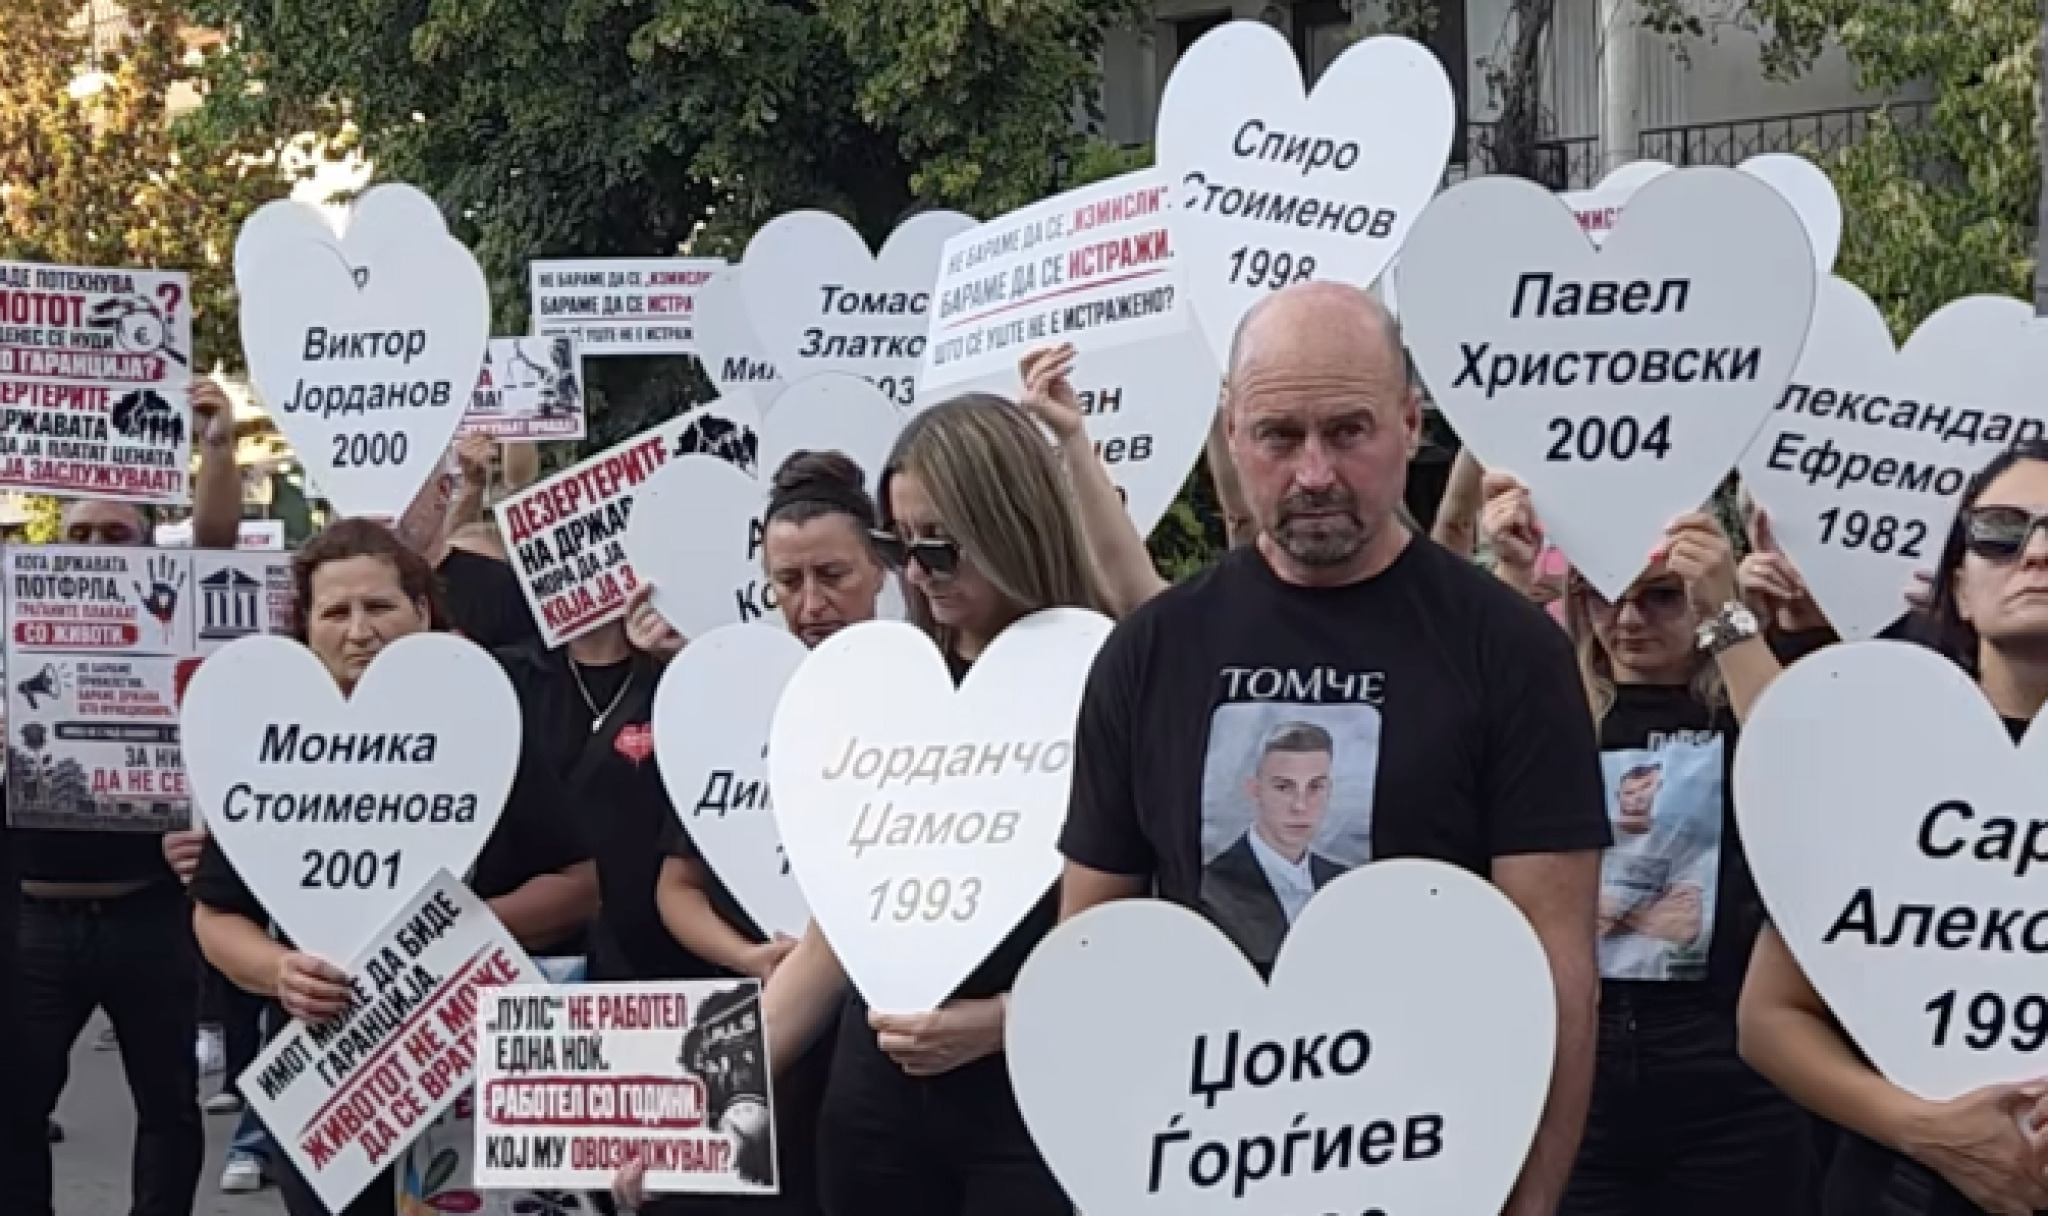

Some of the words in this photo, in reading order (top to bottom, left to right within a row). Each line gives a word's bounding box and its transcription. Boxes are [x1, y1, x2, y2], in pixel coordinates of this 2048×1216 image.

[1232, 119, 1360, 176] Спиро
[965, 227, 1022, 272] БАРАМЕ
[1023, 218, 1043, 250] ДА
[1046, 213, 1064, 239] СЕ
[37, 271, 135, 294] ПОТЕКНУВА
[940, 270, 1008, 319] БАРАМЕ
[1009, 260, 1037, 300] ДА
[1041, 252, 1064, 285] СЕ
[1068, 228, 1174, 279] ИСТРАЖИ.
[1510, 272, 1691, 318] Павел
[540, 295, 599, 316] БАРАМЕ
[601, 295, 625, 316] ДА
[626, 295, 644, 313] СЕ
[820, 284, 929, 315] Томас
[987, 316, 1025, 345] УШТЕ
[1027, 311, 1046, 340] НЕ
[1051, 308, 1062, 335] Е
[1063, 283, 1175, 332] ИСТРАЖЕНО?
[303, 326, 426, 364] Виктор
[1452, 341, 1762, 399] Христовски
[284, 377, 453, 419] Јорданов
[1773, 383, 2046, 449] лександар
[332, 431, 408, 468] 2000
[1546, 412, 1672, 461] 2004
[1767, 431, 1965, 496] Ефремо
[504, 435, 668, 546] ДЕЗЕРТЕРИТЕ
[518, 536, 555, 576] НА
[1818, 507, 1938, 559] 1982
[15, 555, 48, 570] КОГА
[53, 555, 128, 571] ДРЖАВАТА
[531, 563, 578, 599] МОРА
[577, 552, 603, 581] ДА
[604, 540, 628, 568] ЈА
[15, 575, 126, 605] ПОТФРЛА,
[540, 585, 596, 630] КОЈА
[596, 573, 627, 606] ЈА
[24, 624, 47, 643] СО
[1220, 665, 1387, 705] ТОМЧЕ
[125, 745, 147, 768] ЗА
[259, 723, 438, 764] Моника
[821, 736, 1071, 790] Јорданчо
[92, 768, 120, 797] ДА
[128, 769, 154, 791] НЕ
[162, 771, 186, 793] СЕ
[223, 782, 478, 822] Стоименова
[693, 769, 771, 819] Ди
[847, 802, 1021, 859] Џамов
[301, 850, 402, 889] 2001
[870, 876, 983, 923] 1993
[256, 1034, 313, 1101] ИМОТ
[365, 946, 407, 994] ДА
[395, 889, 462, 957] БИДЕ
[568, 994, 595, 1030] НЕ
[599, 993, 689, 1030] РАБОТЕЛ
[315, 965, 443, 1089] ГАРАНЦИЈА.
[497, 1035, 557, 1075] ЕДНА
[1190, 1028, 1372, 1109] Џоко
[302, 1052, 411, 1172] ЖИВОТОТ
[403, 1020, 447, 1067] НЕ
[491, 1083, 588, 1119] РАБОТЕЛ
[589, 1083, 616, 1118] СО
[620, 1083, 701, 1125] ГОДИНИ.
[358, 1117, 401, 1165] ДА
[390, 1087, 429, 1128] СЕ
[485, 1136, 529, 1170] КОЈ
[534, 1136, 567, 1170] МУ
[571, 1138, 731, 1173] ОВОЗМОЖУВАЛ?
[1147, 1112, 1445, 1199] Ѓорѓиев
